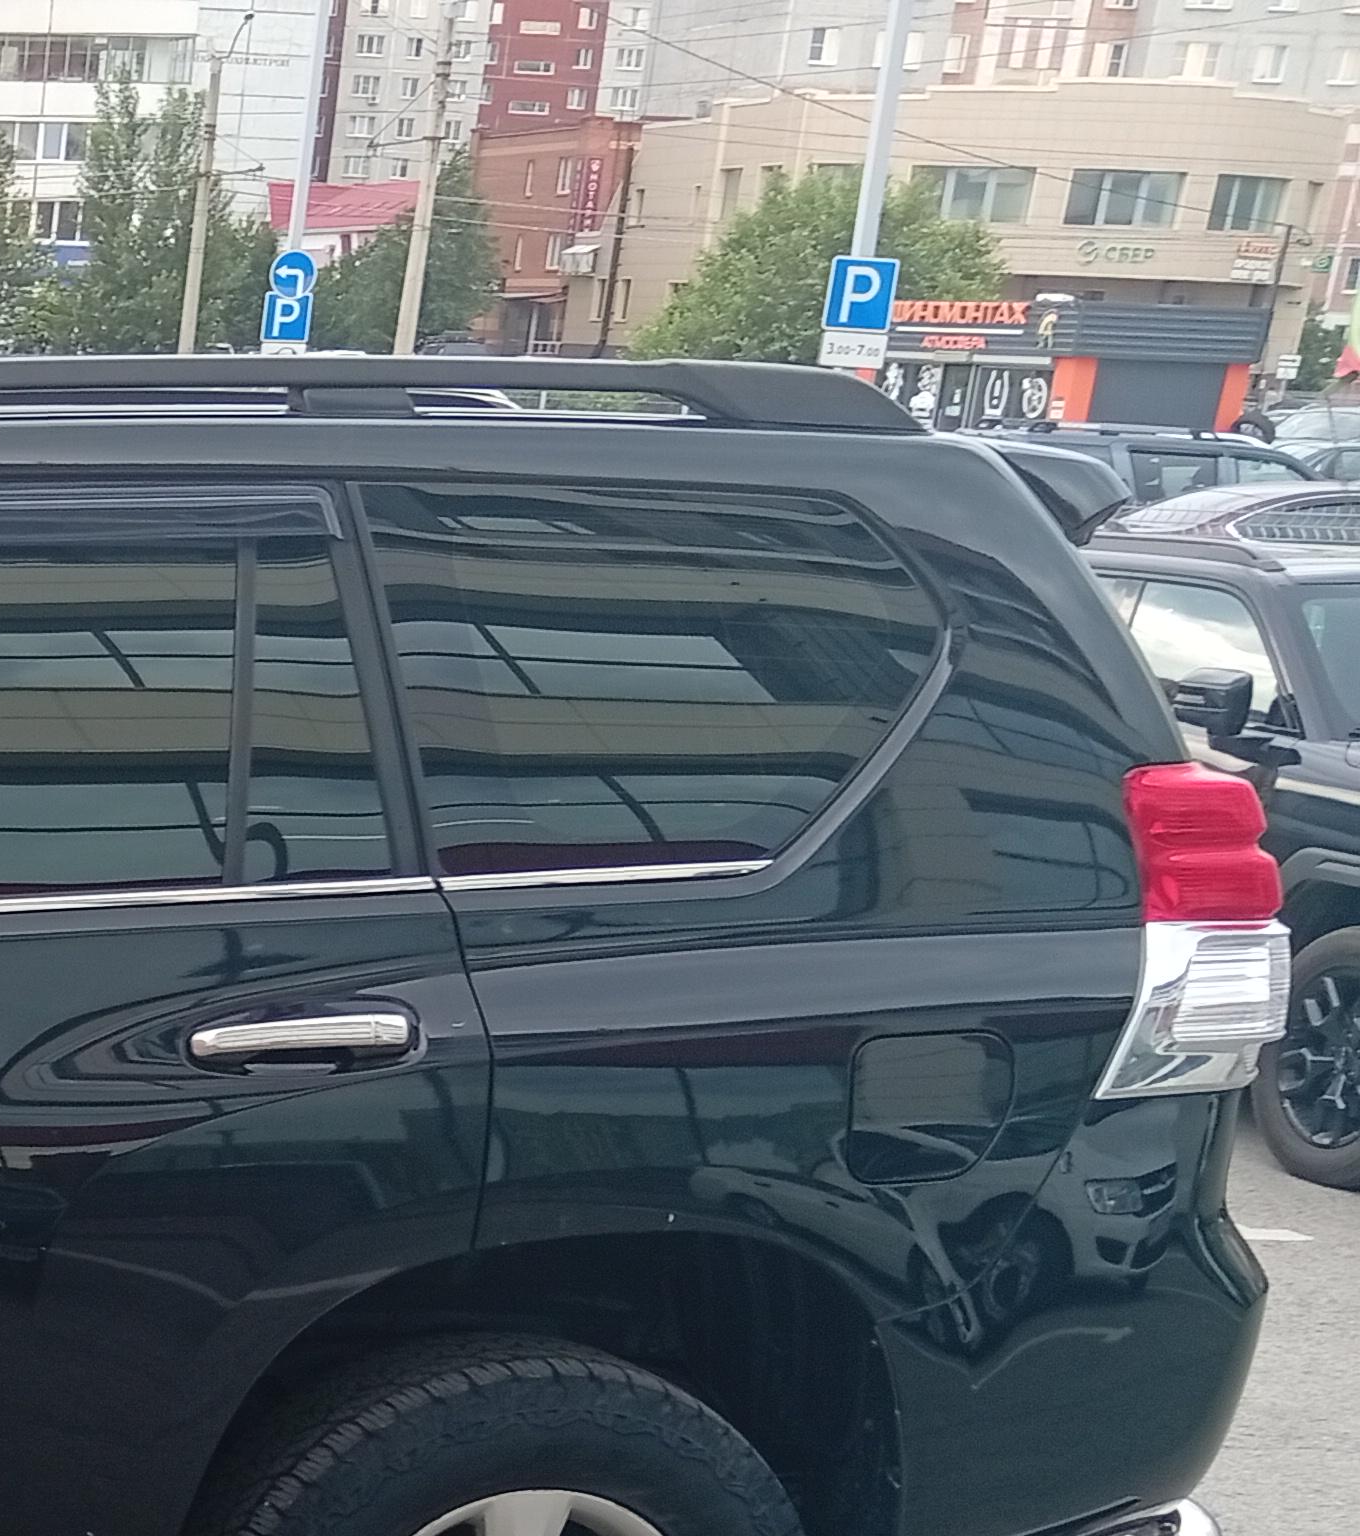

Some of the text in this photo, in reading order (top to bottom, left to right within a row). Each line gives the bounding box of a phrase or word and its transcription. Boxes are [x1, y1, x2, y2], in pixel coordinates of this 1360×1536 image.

[1105, 246, 1155, 263] СБЕР
[839, 266, 881, 323] P
[271, 299, 300, 337] P
